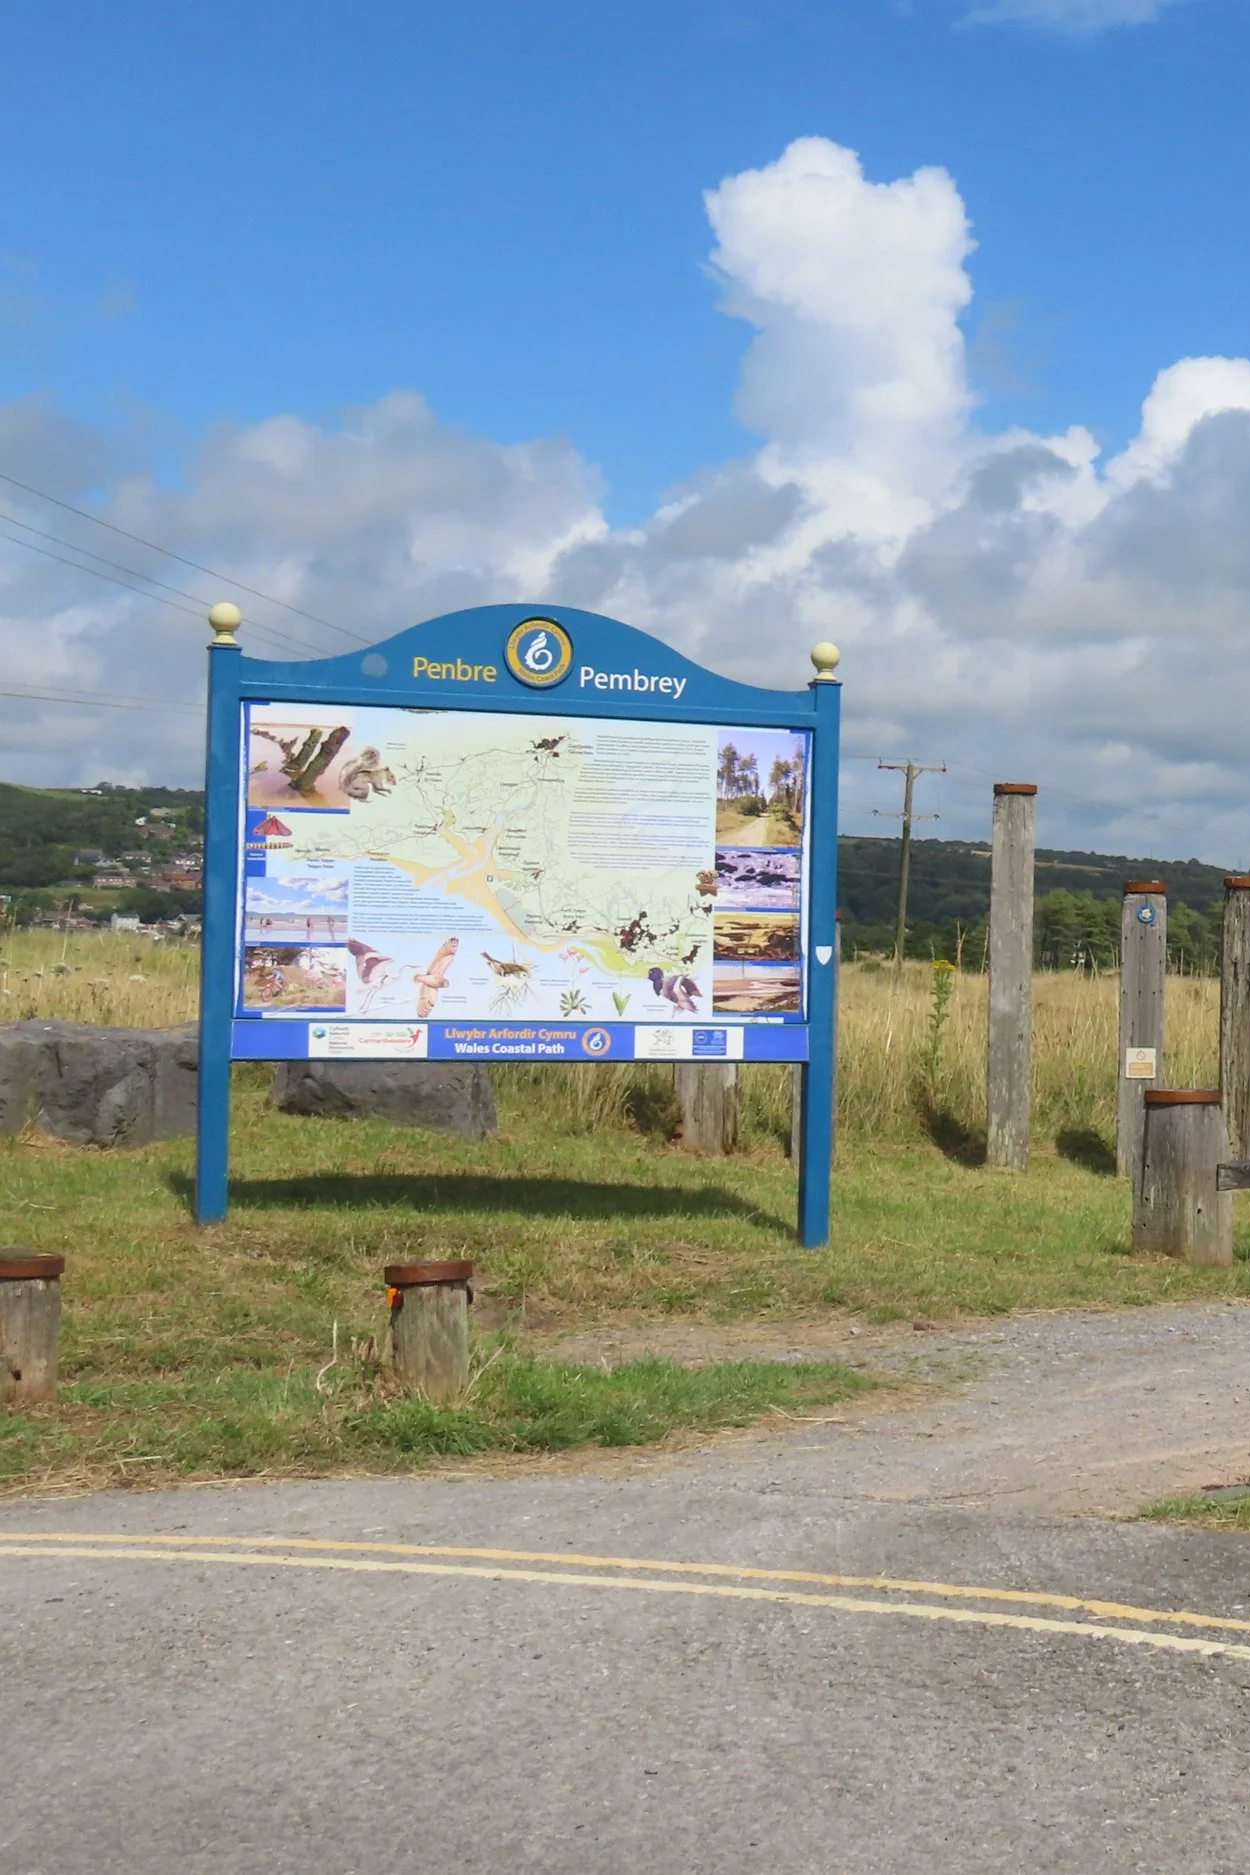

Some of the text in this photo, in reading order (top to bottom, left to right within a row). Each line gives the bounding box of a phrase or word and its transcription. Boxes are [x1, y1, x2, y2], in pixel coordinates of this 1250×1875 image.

[413, 656, 497, 682] Penbre
[580, 666, 687, 699] Pembrey
[445, 1028, 577, 1041] Llwybr Arfordir Cymru
[454, 1043, 565, 1054] Wales Coastal Path
